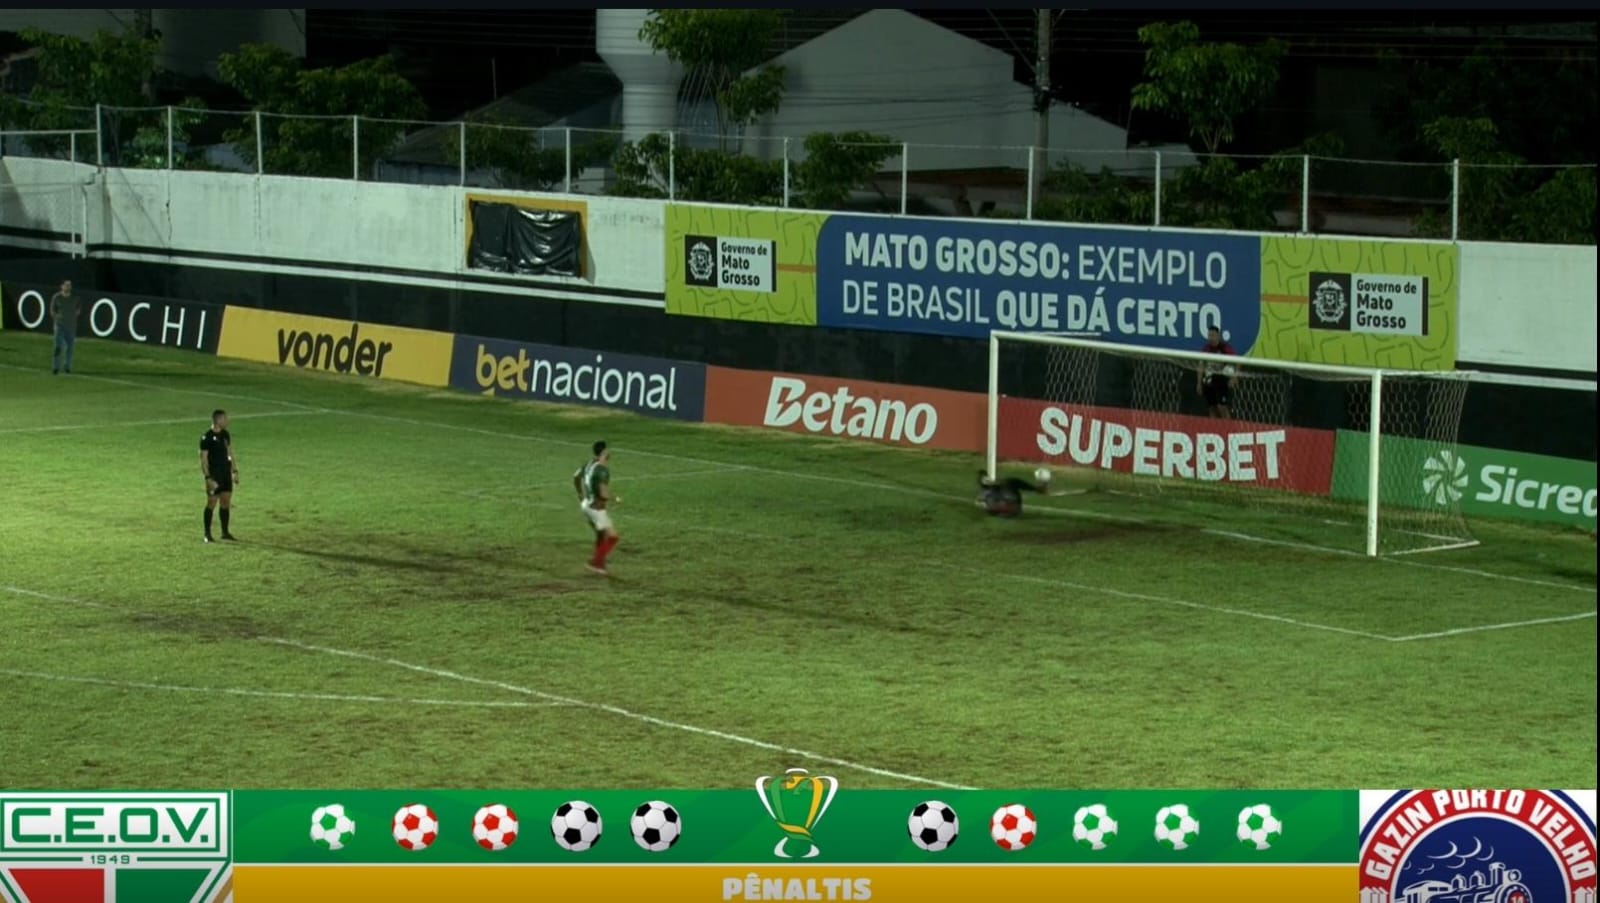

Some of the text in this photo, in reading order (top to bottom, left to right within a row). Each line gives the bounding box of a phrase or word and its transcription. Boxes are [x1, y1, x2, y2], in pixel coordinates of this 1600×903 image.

[721, 241, 768, 256] Governo de
[721, 254, 750, 270] Mato
[845, 231, 1228, 290] MATO GROSSO: EXEMPLO
[721, 269, 760, 286] Grosso
[1356, 279, 1417, 294] Governo de
[1356, 293, 1393, 310] Mato
[17, 290, 207, 349] OOCHI
[843, 280, 1232, 342] DE BRASIL QUE DÁ CERTO.
[1356, 311, 1407, 329] Grosso
[277, 323, 392, 377] vonder
[475, 344, 677, 411] betnacional
[763, 376, 938, 445] Betano
[1036, 407, 1286, 482] SUPERBET
